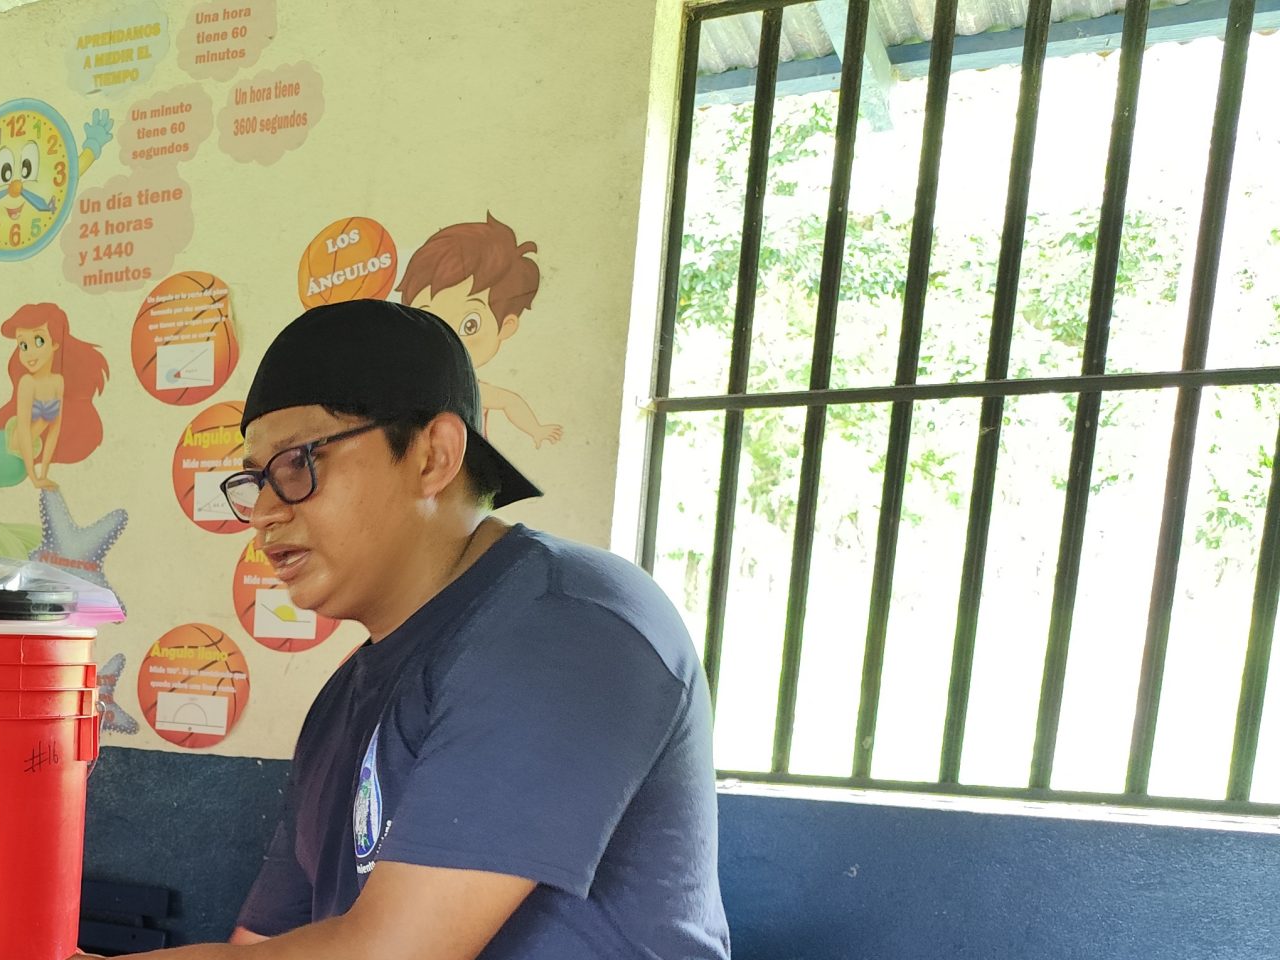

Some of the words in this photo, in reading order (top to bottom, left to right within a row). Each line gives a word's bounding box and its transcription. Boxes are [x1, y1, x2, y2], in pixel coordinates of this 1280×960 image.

[195, 12, 219, 24] Una
[222, 7, 251, 20] hora
[76, 22, 161, 50] APRENDAMOS
[196, 31, 228, 44] tiene
[231, 26, 247, 39] 60
[83, 55, 92, 70] A
[94, 48, 134, 68] MEDIR
[137, 45, 152, 60] EL
[195, 48, 245, 64] minutos
[93, 68, 139, 87] TIEMPO
[235, 88, 247, 105] Un
[250, 86, 272, 103] hora
[274, 81, 300, 99] tiene
[131, 110, 147, 121] Un
[150, 102, 192, 119] minuto
[233, 116, 257, 136] 3600
[259, 109, 308, 134] segundos
[7, 114, 26, 138] 12
[33, 119, 42, 139] 1
[137, 126, 167, 140] tiene
[171, 121, 185, 134] 60
[47, 135, 58, 155] 2
[131, 141, 190, 160] segundos
[53, 161, 67, 187] 3
[79, 199, 101, 214] Un
[106, 192, 132, 211] día
[137, 187, 183, 205] tiene
[9, 223, 21, 247] 6
[30, 218, 42, 238] 5
[79, 222, 100, 239] 24
[104, 217, 154, 236] horas
[325, 229, 360, 254] LOS
[78, 251, 88, 266] y
[92, 241, 134, 261] 1440
[83, 266, 152, 287] minutos
[306, 252, 392, 297] ÁNGULOS
[183, 424, 230, 448] Ángulo
[151, 642, 194, 661] Ángulo
[198, 646, 228, 661] llano
[24, 740, 59, 773] #16
